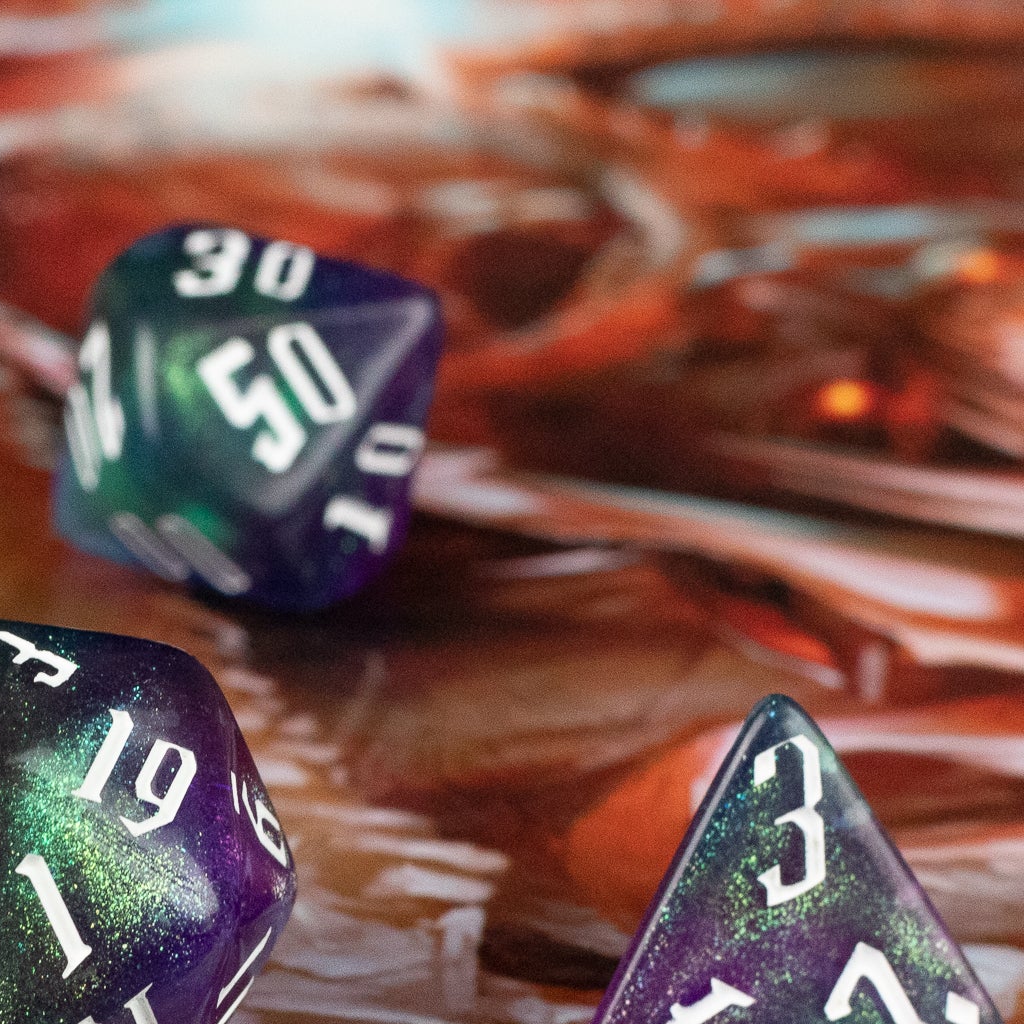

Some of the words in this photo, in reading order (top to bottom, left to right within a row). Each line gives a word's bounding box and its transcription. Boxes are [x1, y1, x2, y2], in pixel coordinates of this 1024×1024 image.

[174, 228, 316, 301] 30
[196, 321, 358, 474] 50
[323, 422, 426, 555] 10
[72, 708, 198, 838] 19
[752, 733, 826, 908] 3
[15, 852, 93, 981] 1
